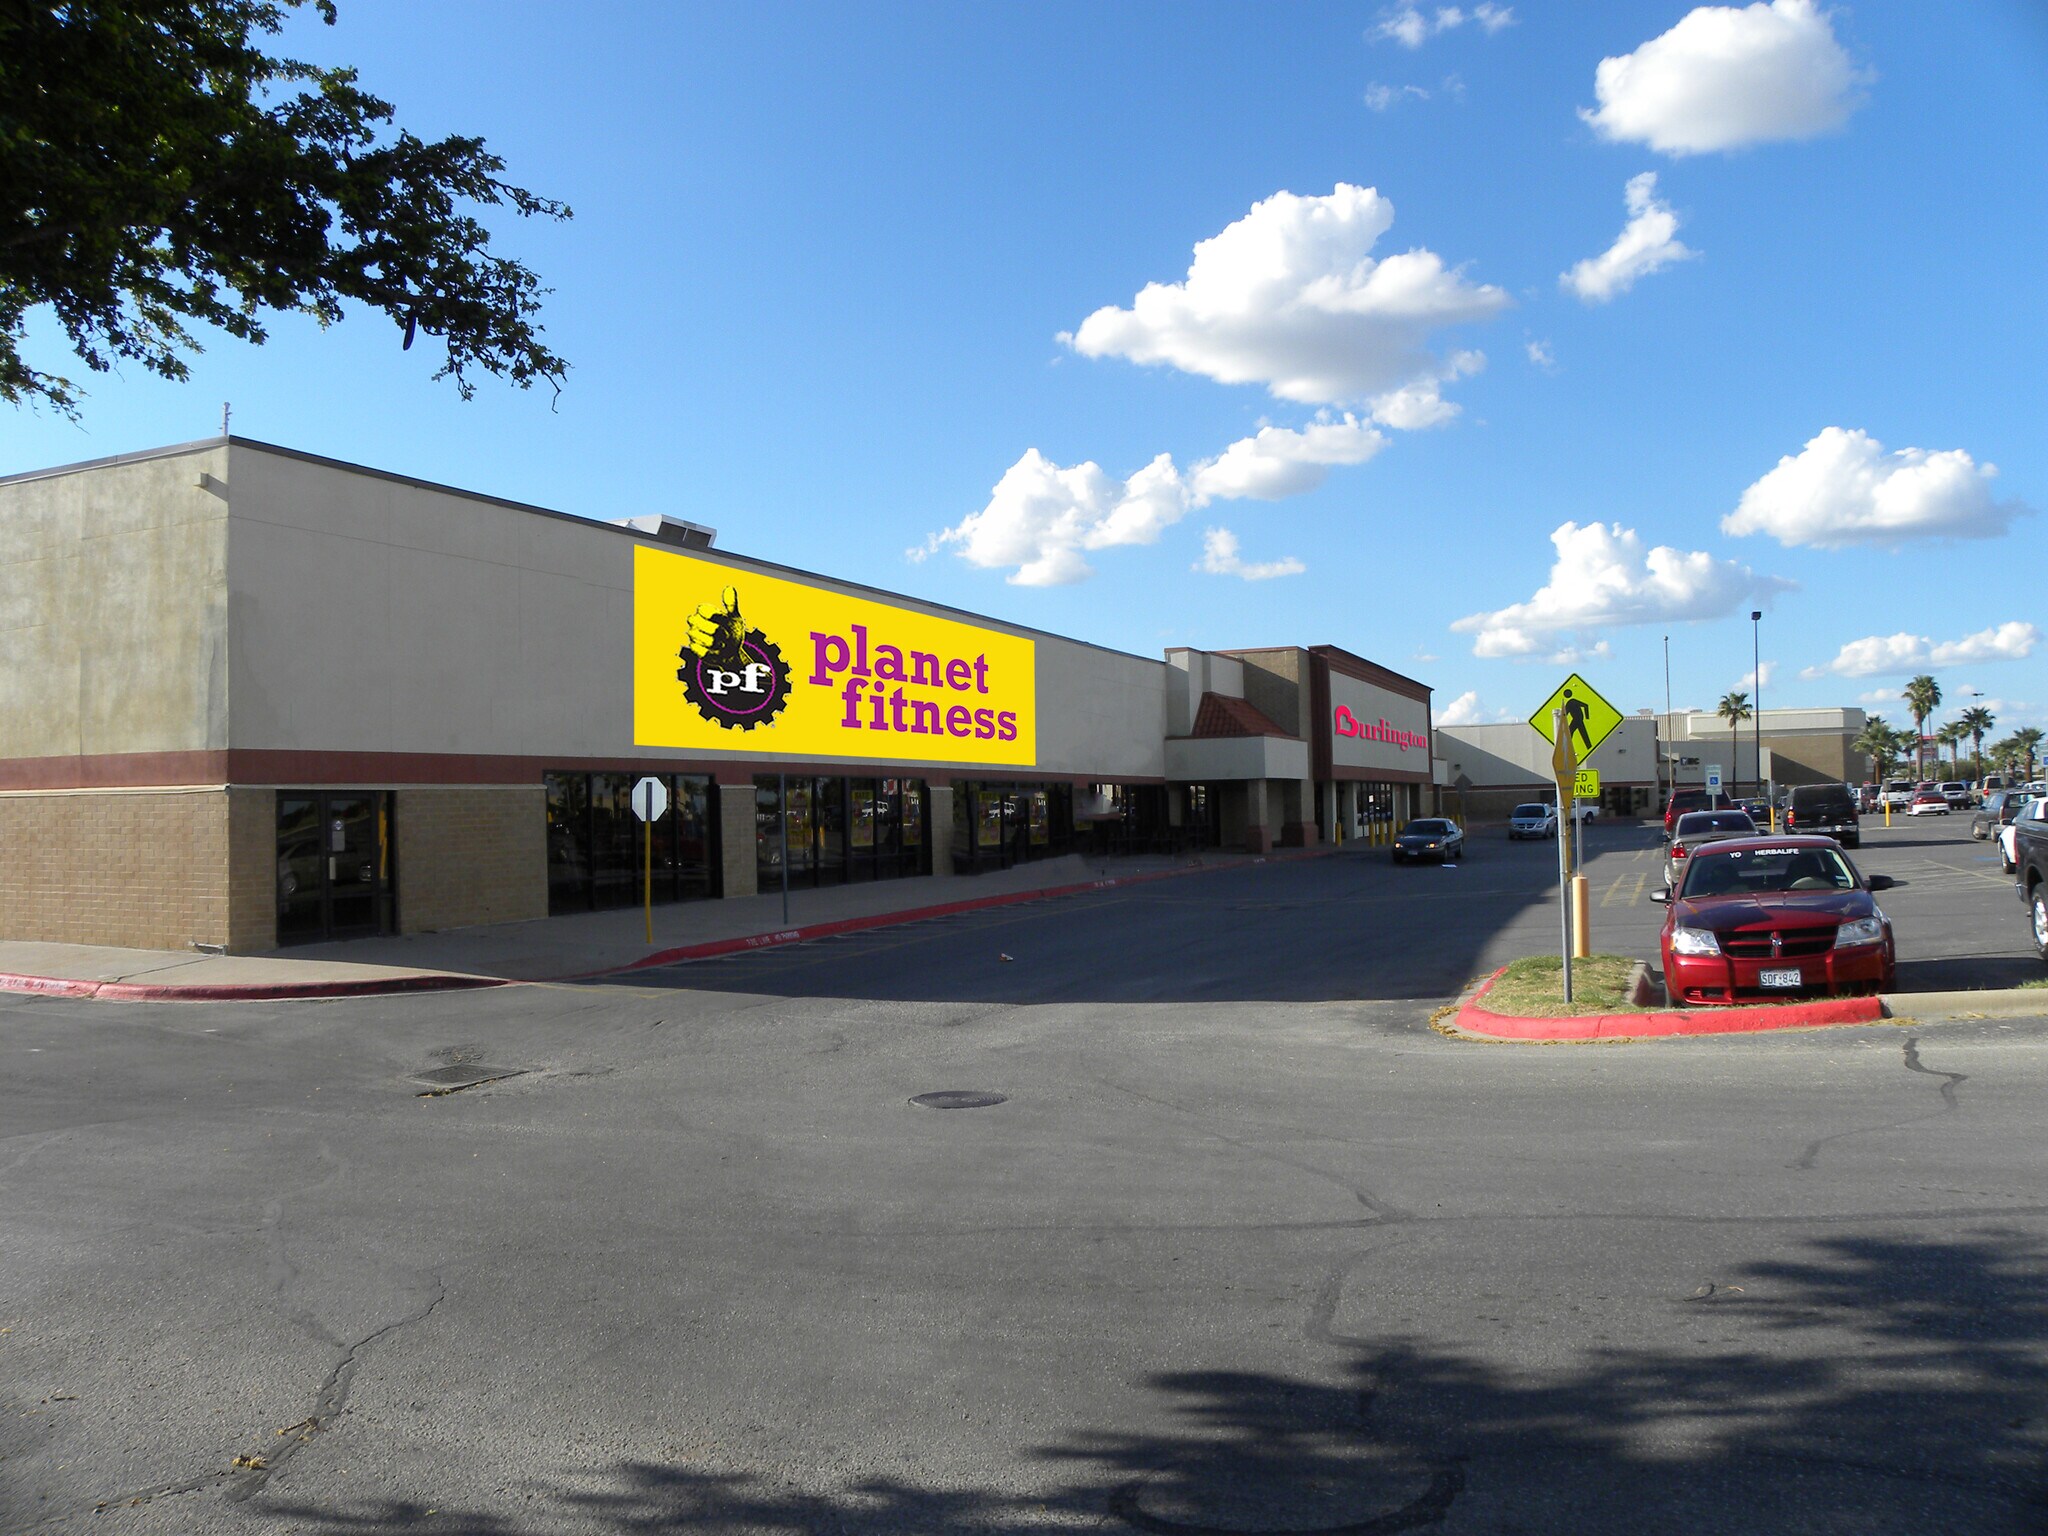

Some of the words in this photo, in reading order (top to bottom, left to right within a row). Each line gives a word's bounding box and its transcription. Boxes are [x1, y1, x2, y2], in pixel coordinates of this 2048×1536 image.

[809, 624, 989, 694] planet
[706, 662, 771, 695] pf
[841, 677, 1018, 741] fitness
[1335, 704, 1427, 751] Burlington
[1575, 773, 1588, 782] ED
[1576, 784, 1593, 794] ING
[1729, 851, 1742, 859] YO
[1755, 848, 1799, 857] HERBALIFE
